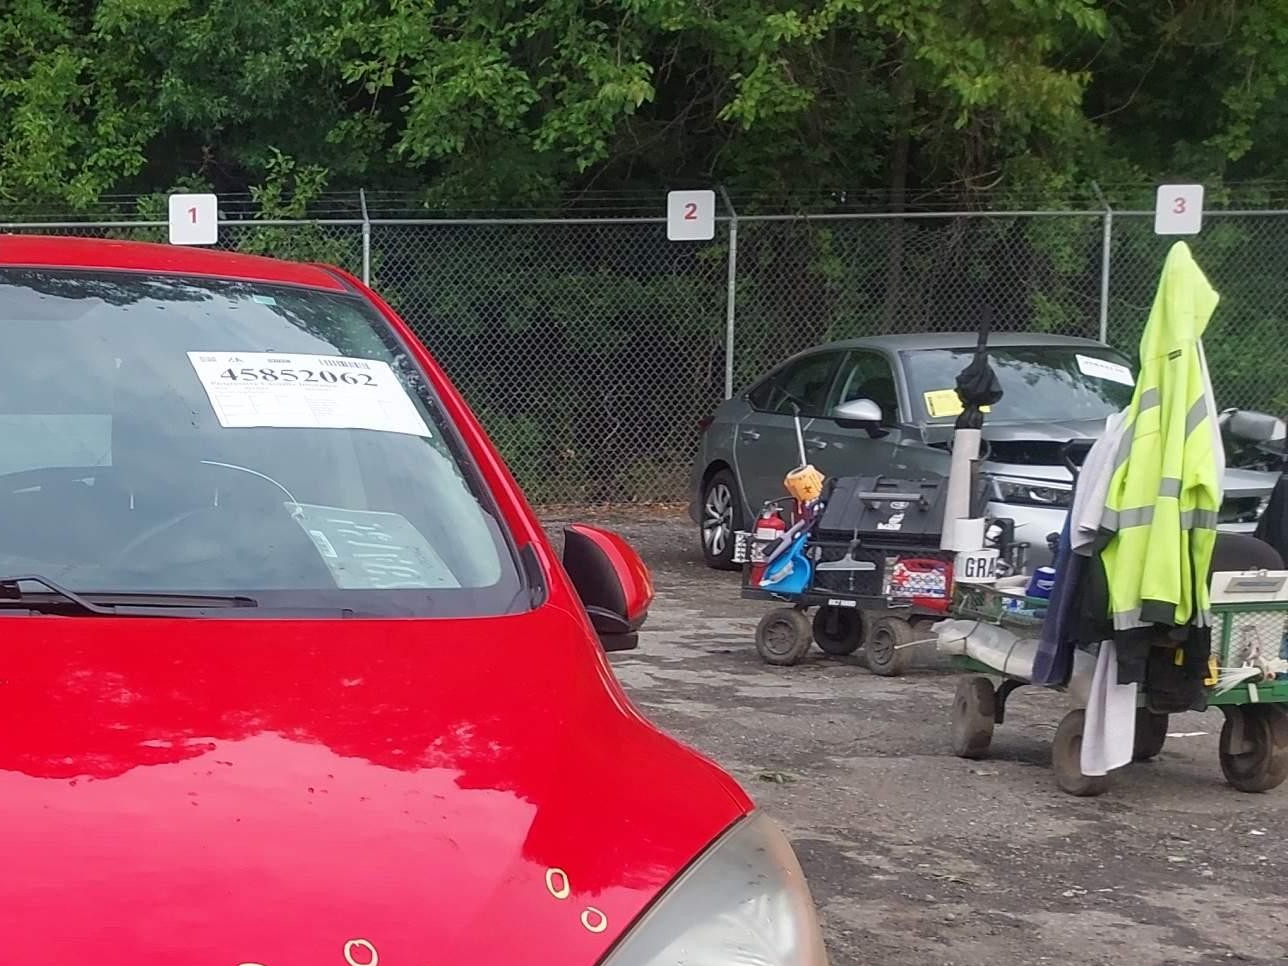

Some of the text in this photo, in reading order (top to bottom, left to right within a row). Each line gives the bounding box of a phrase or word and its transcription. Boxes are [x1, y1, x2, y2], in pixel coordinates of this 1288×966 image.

[684, 203, 697, 220] 2
[1173, 197, 1186, 214] 3
[188, 207, 197, 224] 1
[220, 368, 378, 387] 45852062
